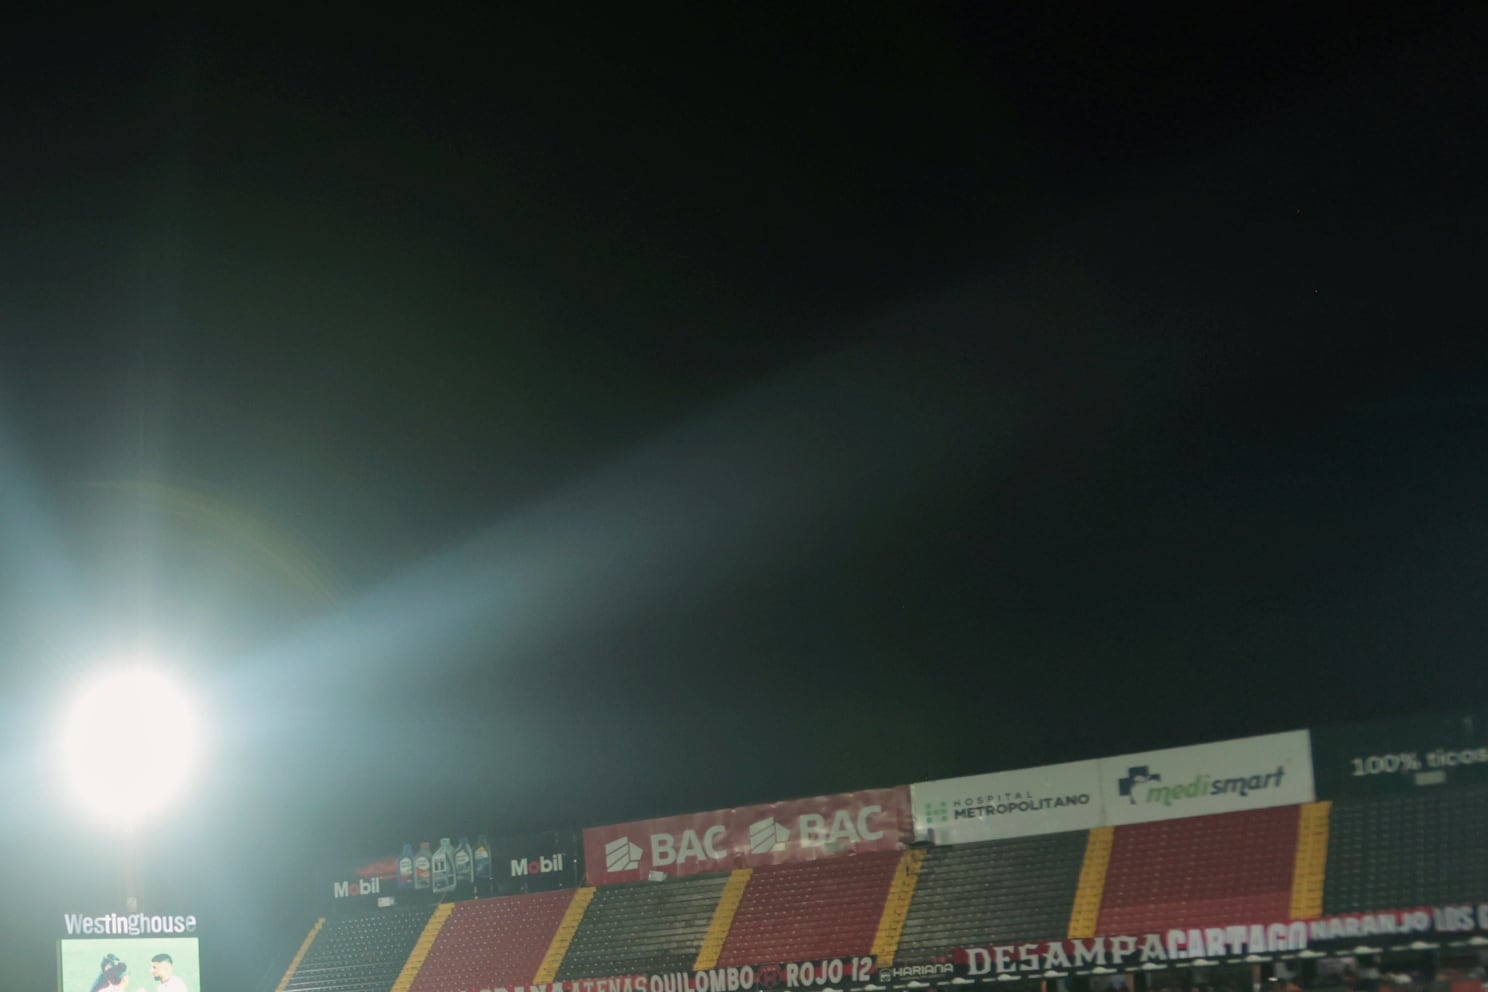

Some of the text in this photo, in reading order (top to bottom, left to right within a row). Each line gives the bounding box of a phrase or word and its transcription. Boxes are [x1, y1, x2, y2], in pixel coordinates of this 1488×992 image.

[1350, 753, 1421, 776] 100%
[953, 791, 1032, 807] HOSPITAL
[1147, 765, 1285, 806] medismart
[954, 794, 1090, 820] METROPOLITANO
[799, 805, 884, 846] BAC
[651, 825, 728, 866] BAC
[511, 855, 563, 877] Mobil
[334, 877, 380, 898] Mobil
[64, 913, 197, 935] Westinghouse
[1309, 911, 1430, 940] NARANJO
[1167, 921, 1308, 959] CARTAGO
[786, 956, 873, 987] ROJO 12
